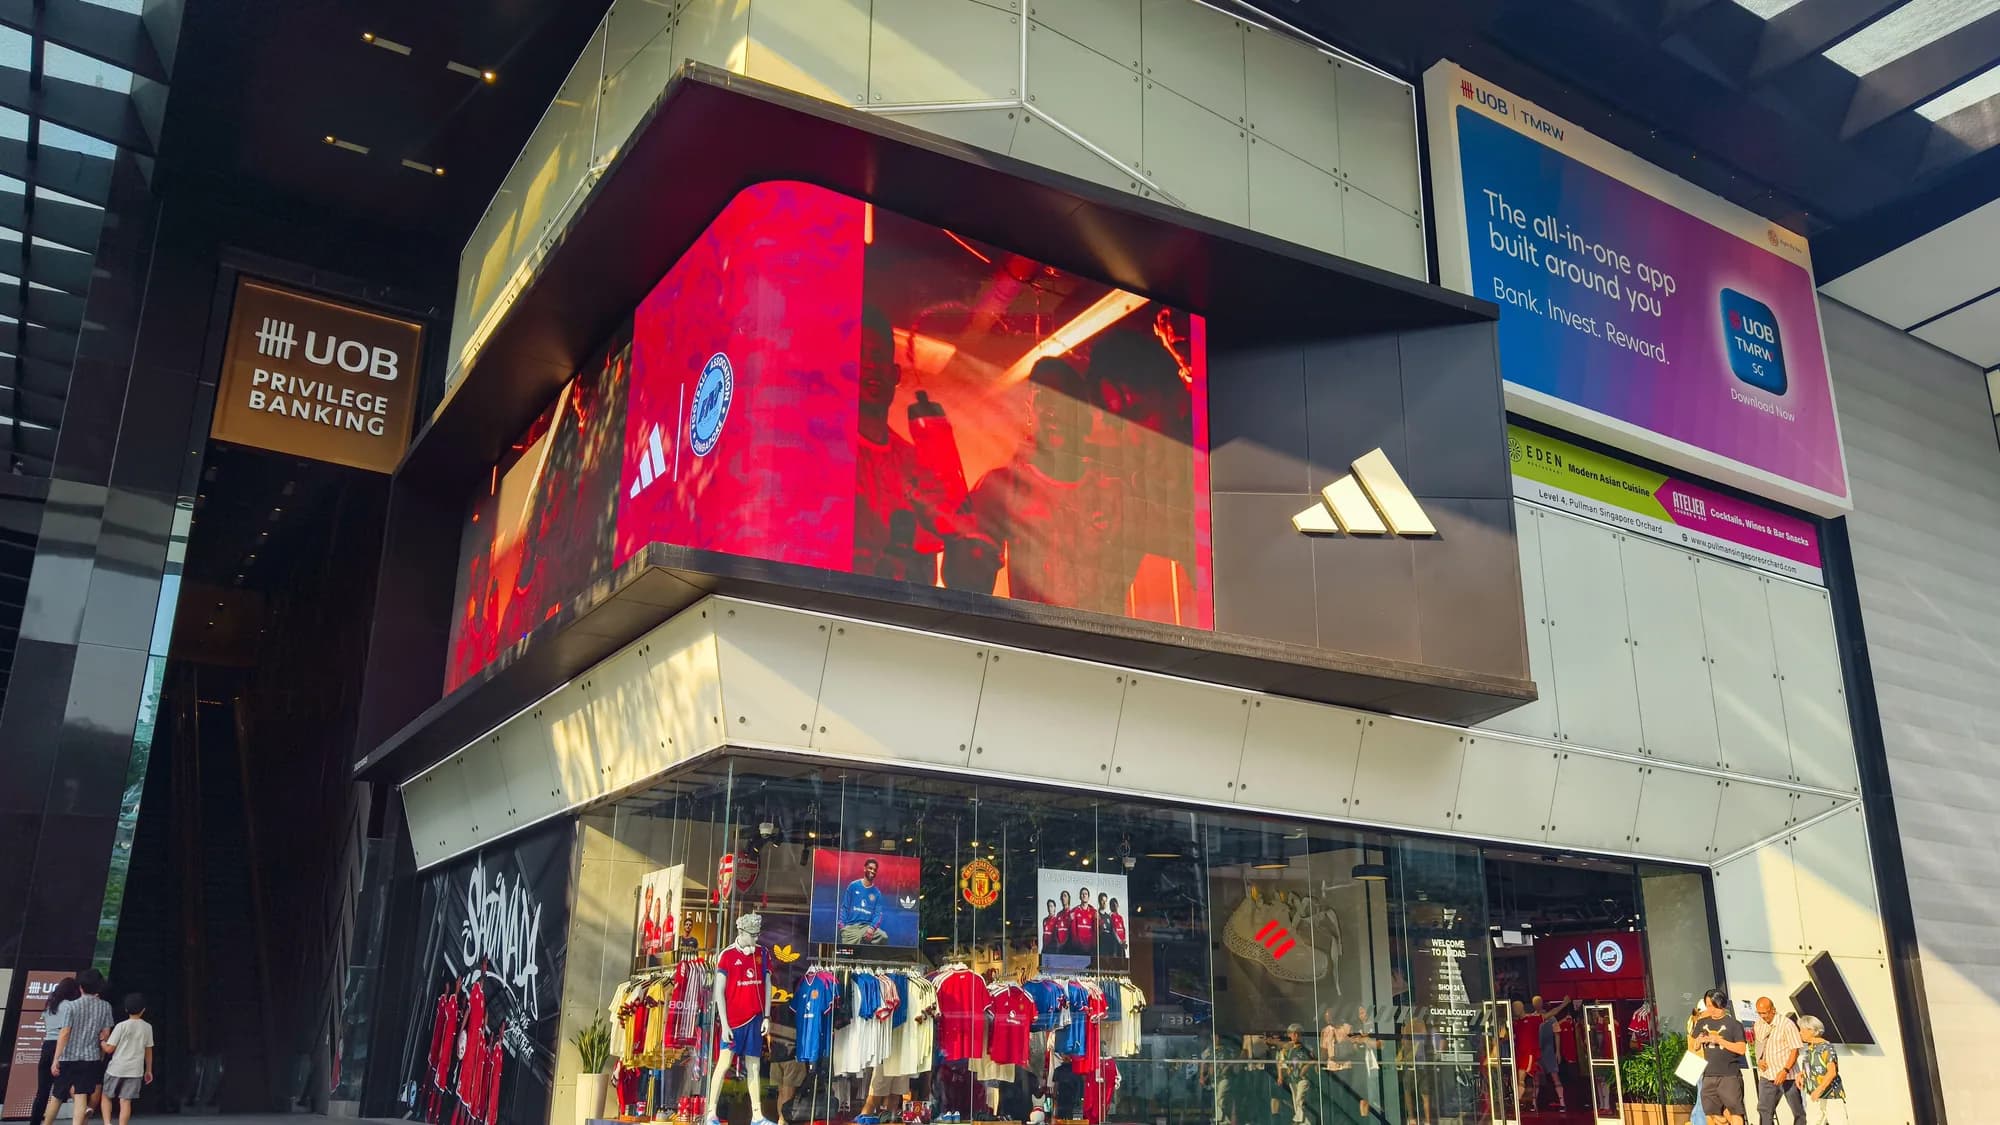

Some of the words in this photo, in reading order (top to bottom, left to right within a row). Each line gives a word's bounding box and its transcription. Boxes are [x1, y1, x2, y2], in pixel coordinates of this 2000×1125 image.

[1476, 88, 1508, 115] UOB
[1520, 110, 1564, 141] TMRW
[1483, 188, 1527, 229] The
[1533, 214, 1631, 274] all-in-one
[1637, 262, 1676, 297] app
[1488, 222, 1540, 267] built
[1545, 252, 1620, 300] around
[1625, 286, 1662, 318] you
[1493, 276, 1542, 315] Bank.
[1547, 298, 1602, 338] Invest.
[1605, 321, 1670, 366] Reward.
[1742, 315, 1775, 344] UOB
[304, 330, 399, 382] UOB
[1734, 336, 1774, 364] TMRW
[1751, 362, 1764, 377] SG
[252, 368, 388, 416] PRIVILEGE
[1730, 387, 1774, 414] Download
[1776, 404, 1796, 422] Now
[248, 390, 386, 436] BANKING
[1526, 444, 1562, 468] EDEN
[1568, 463, 1598, 480] Modern
[1600, 473, 1621, 488] Asian
[1622, 480, 1650, 497] Cuisine
[1538, 488, 1559, 502] Level
[1560, 496, 1568, 506] 4,
[1569, 498, 1598, 514] Pullman
[1599, 507, 1634, 526] Singapore
[1635, 518, 1663, 534] Orchard
[1672, 490, 1706, 516] ATELIER
[1710, 508, 1744, 528] Cocktails,
[1745, 520, 1766, 533] Wines
[1766, 526, 1772, 535] &
[1773, 528, 1784, 539] Bar
[1786, 532, 1808, 546] Snacks
[1432, 938, 1465, 948] WELCOME
[1432, 948, 1441, 956] TO
